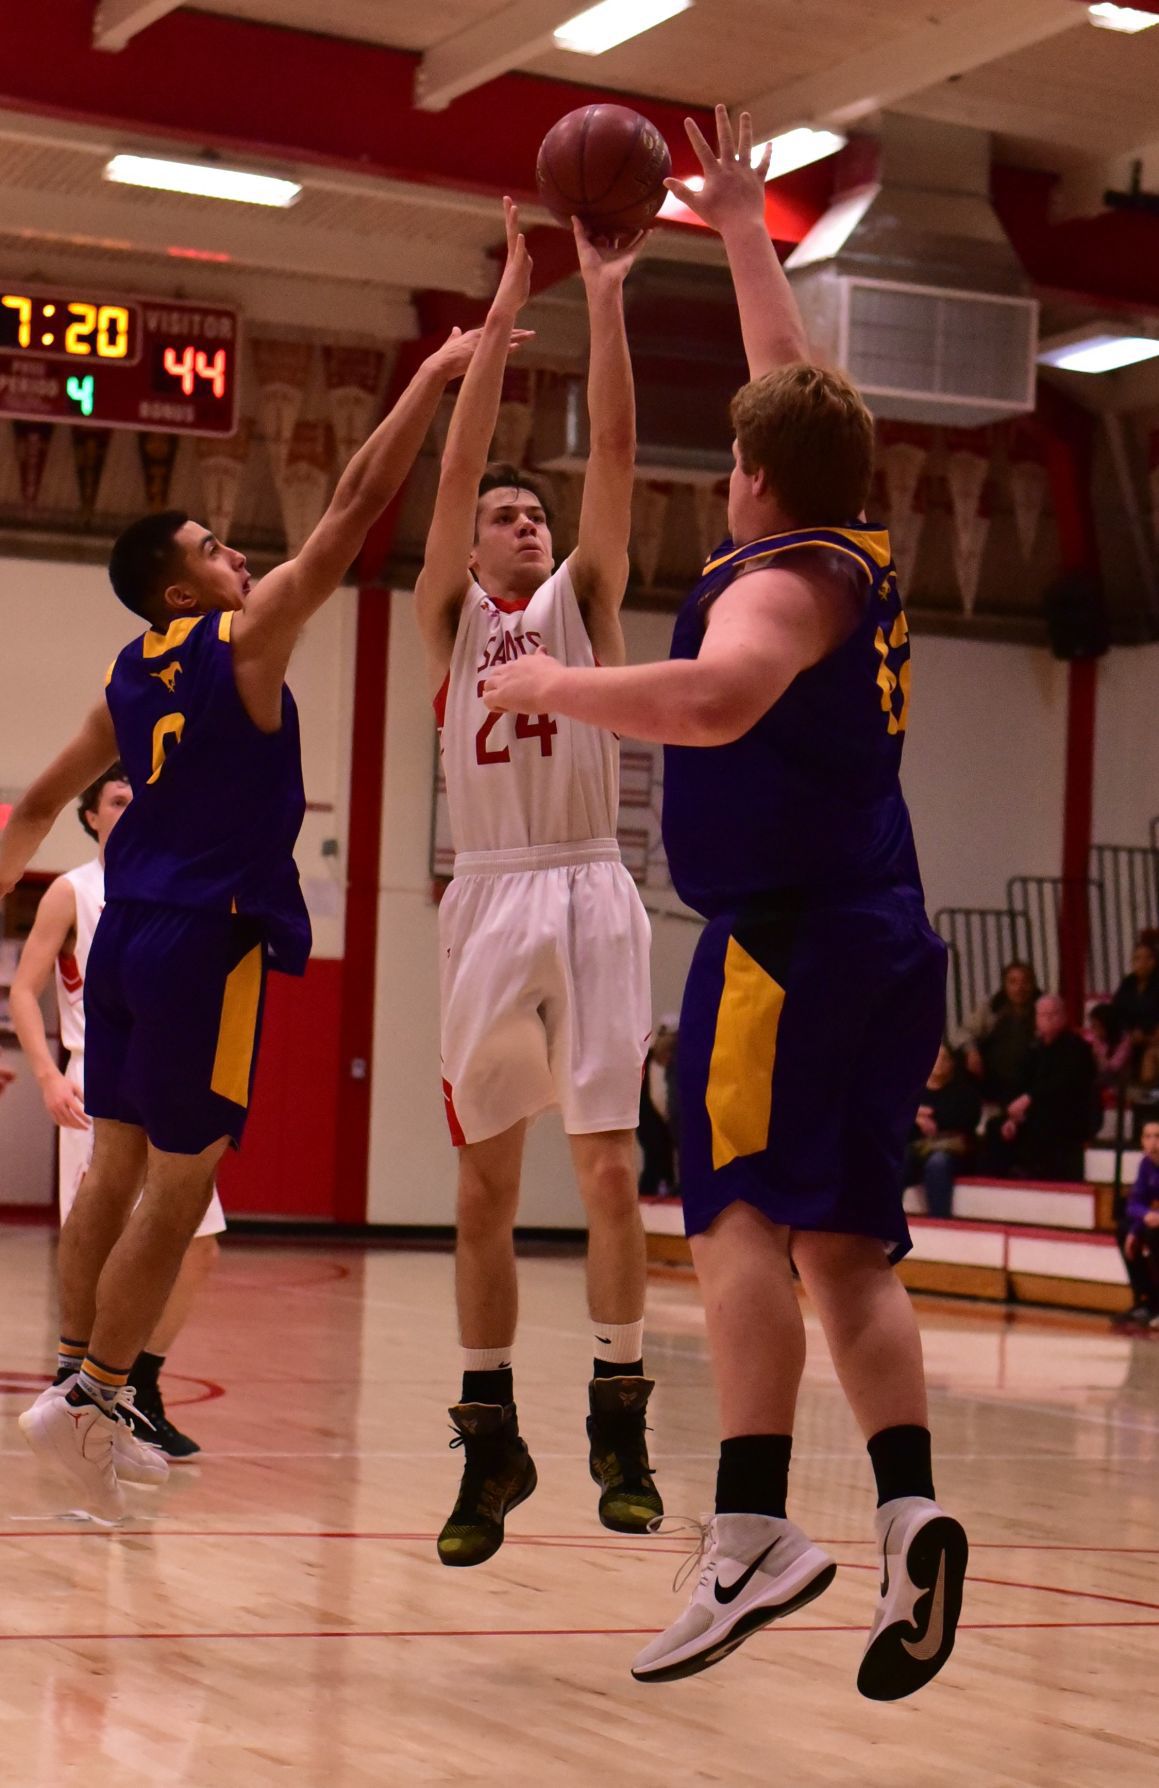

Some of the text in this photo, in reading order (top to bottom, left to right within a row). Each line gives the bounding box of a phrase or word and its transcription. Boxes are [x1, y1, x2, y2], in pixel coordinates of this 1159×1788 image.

[1, 294, 129, 358] 7:20
[66, 374, 94, 417] 4
[163, 345, 226, 399] 44
[476, 679, 557, 765] 24
